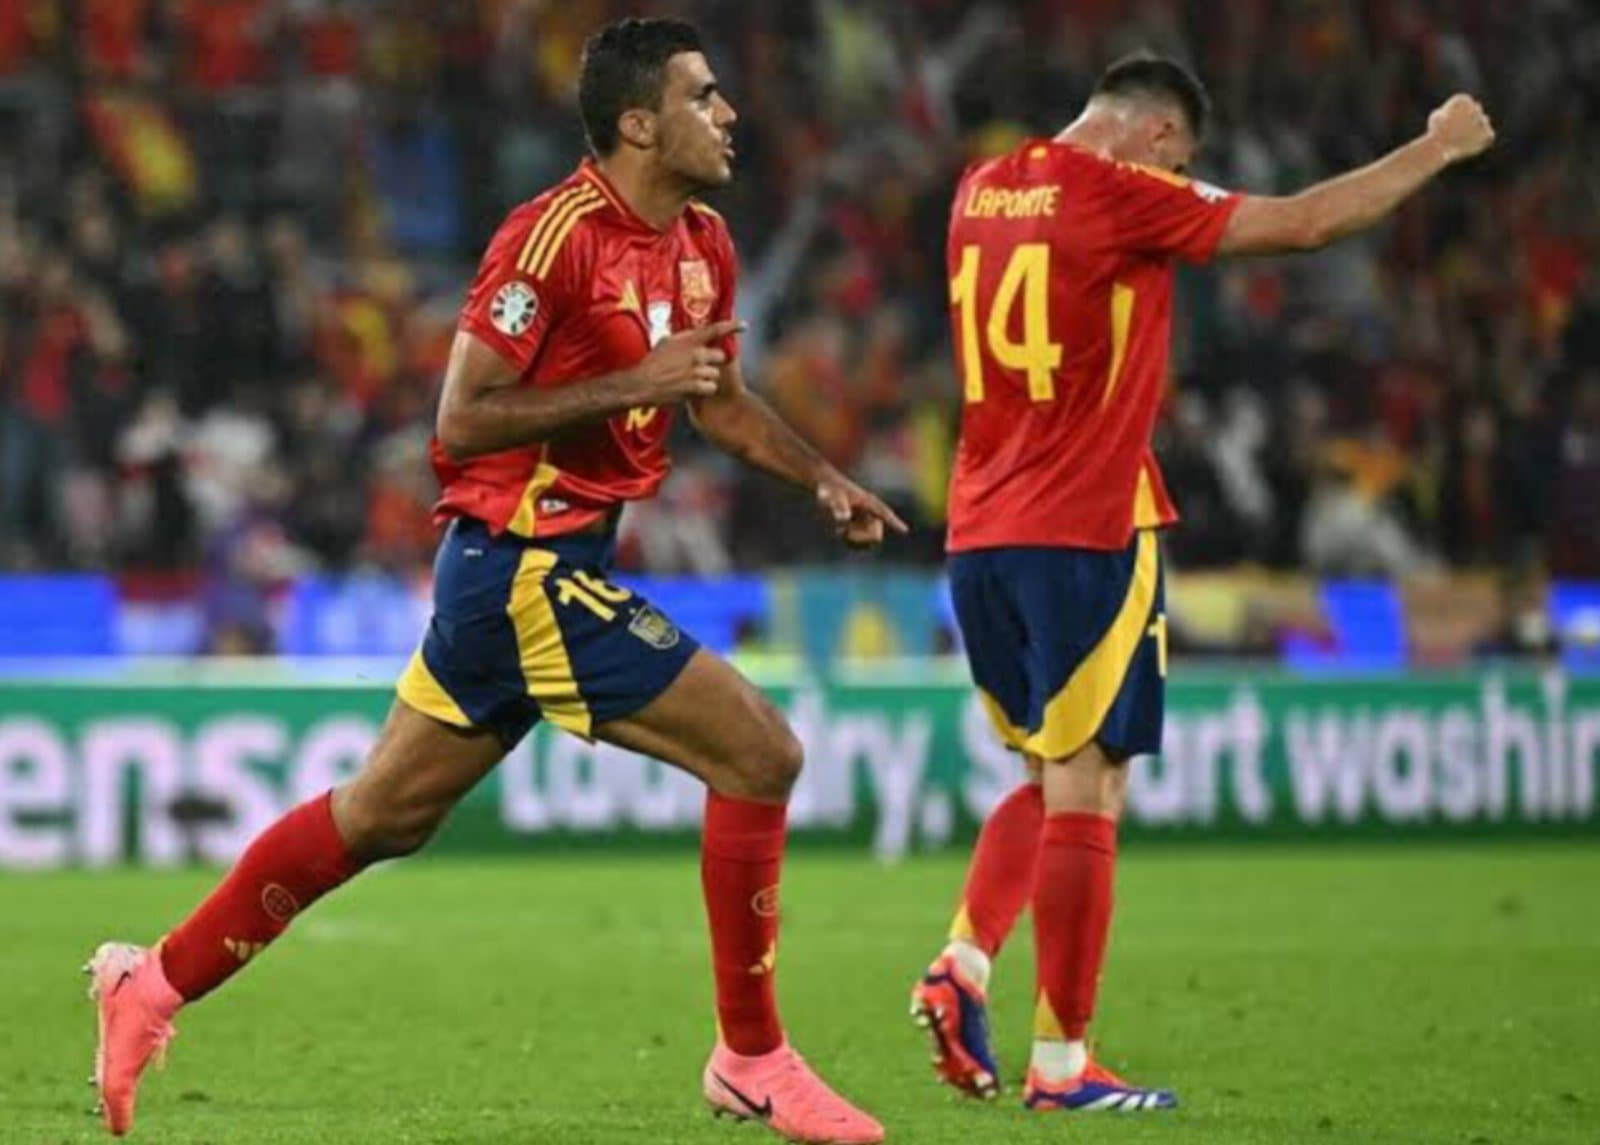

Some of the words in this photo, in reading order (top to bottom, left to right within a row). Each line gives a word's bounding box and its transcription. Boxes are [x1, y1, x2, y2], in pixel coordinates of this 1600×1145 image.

[964, 184, 1062, 219] LAPORTE
[950, 243, 1063, 403] 14
[961, 684, 1270, 826] Sart
